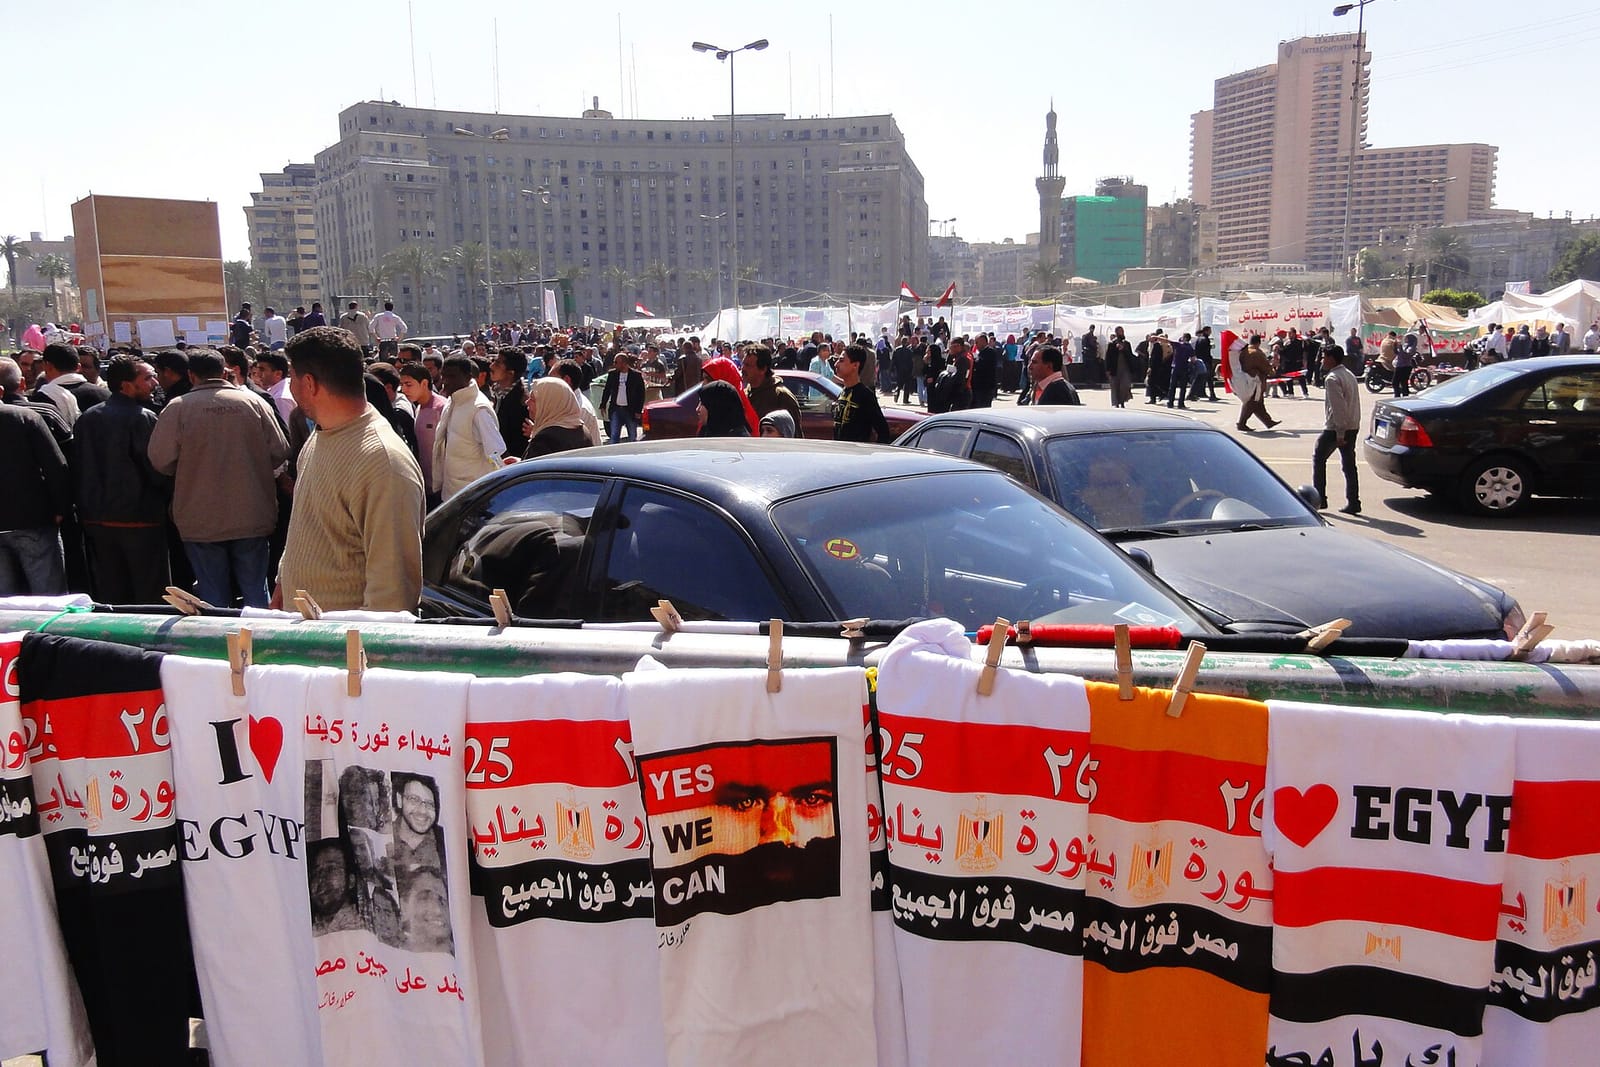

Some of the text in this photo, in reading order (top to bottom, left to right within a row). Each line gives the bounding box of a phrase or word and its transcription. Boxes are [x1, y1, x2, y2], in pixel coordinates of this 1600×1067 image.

[208, 718, 253, 785] I
[351, 722, 390, 752] ثورة
[397, 729, 452, 760] شهداء
[880, 727, 925, 779] 25
[465, 737, 514, 783] 25
[648, 763, 715, 802] YES
[175, 809, 305, 861] EGYP
[661, 817, 714, 854] WE
[1351, 785, 1512, 852] EGYP
[130, 843, 177, 878] مصر
[501, 871, 655, 918] صر فوق الجميع
[662, 865, 726, 905] CAN
[892, 883, 1075, 933] مصر فوق الجميع
[1140, 911, 1180, 956] فوق
[1182, 929, 1239, 961] مصر
[314, 957, 347, 978] مص
[395, 968, 427, 994] على
[1558, 950, 1597, 1000] فوق
[1266, 1045, 1334, 1067] مص
